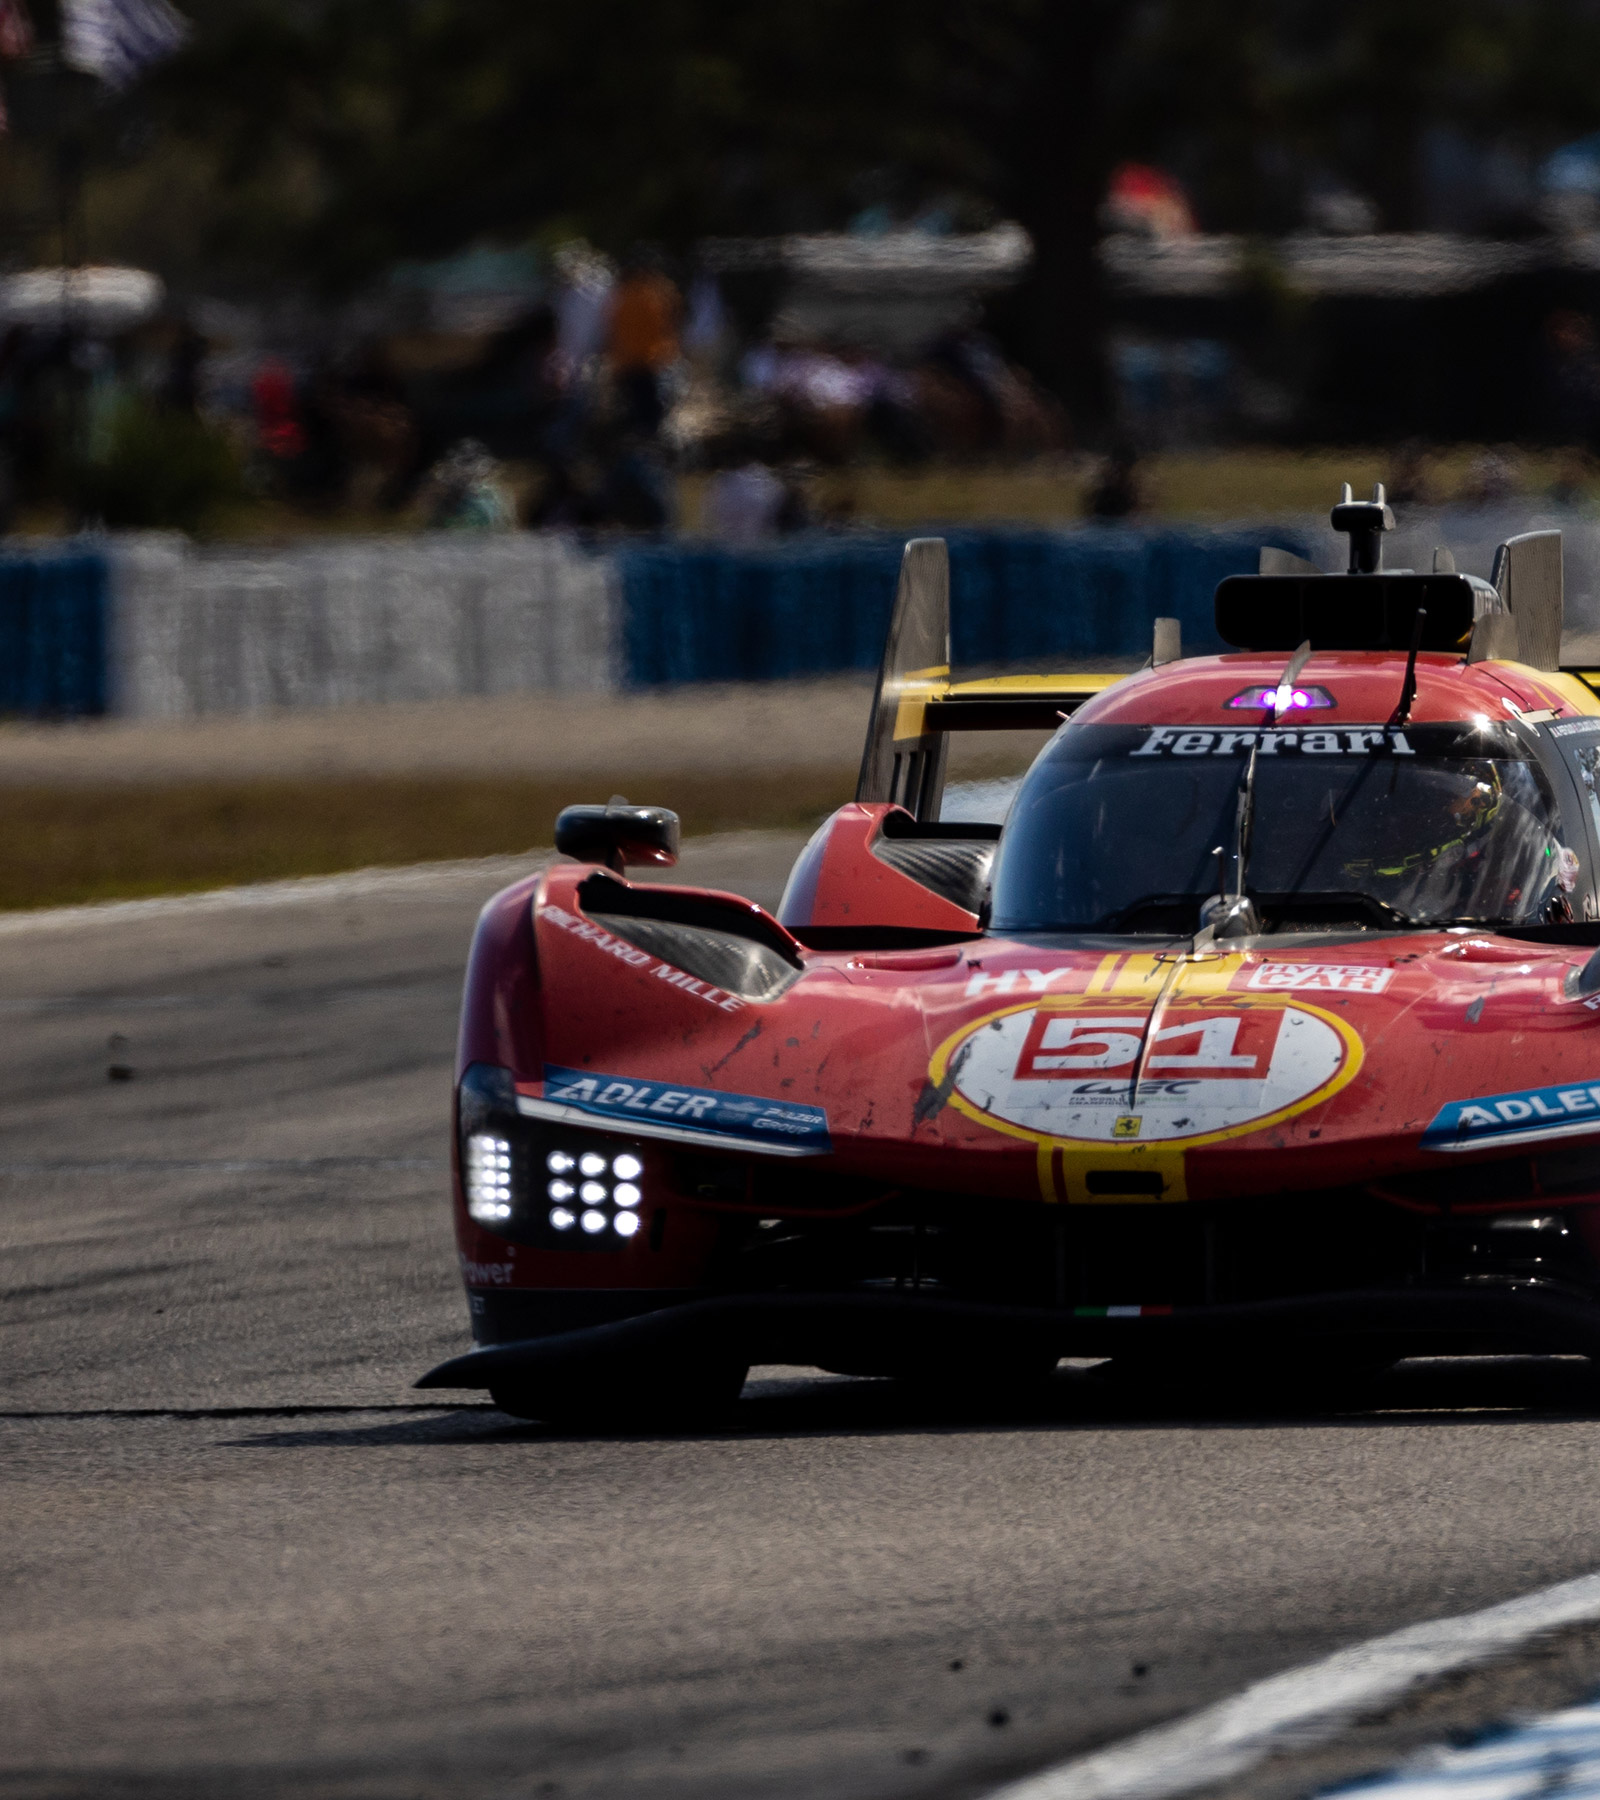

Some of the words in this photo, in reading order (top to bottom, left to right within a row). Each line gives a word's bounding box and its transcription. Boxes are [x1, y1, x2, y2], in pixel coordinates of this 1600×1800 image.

[1129, 725, 1416, 756] Ferrari
[964, 967, 1074, 997] HY
[1258, 972, 1377, 991] CAR
[1265, 964, 1384, 977] HYPER
[649, 963, 747, 1013] MILLE
[1030, 1016, 1259, 1070] 51
[549, 1077, 718, 1118] ADLER
